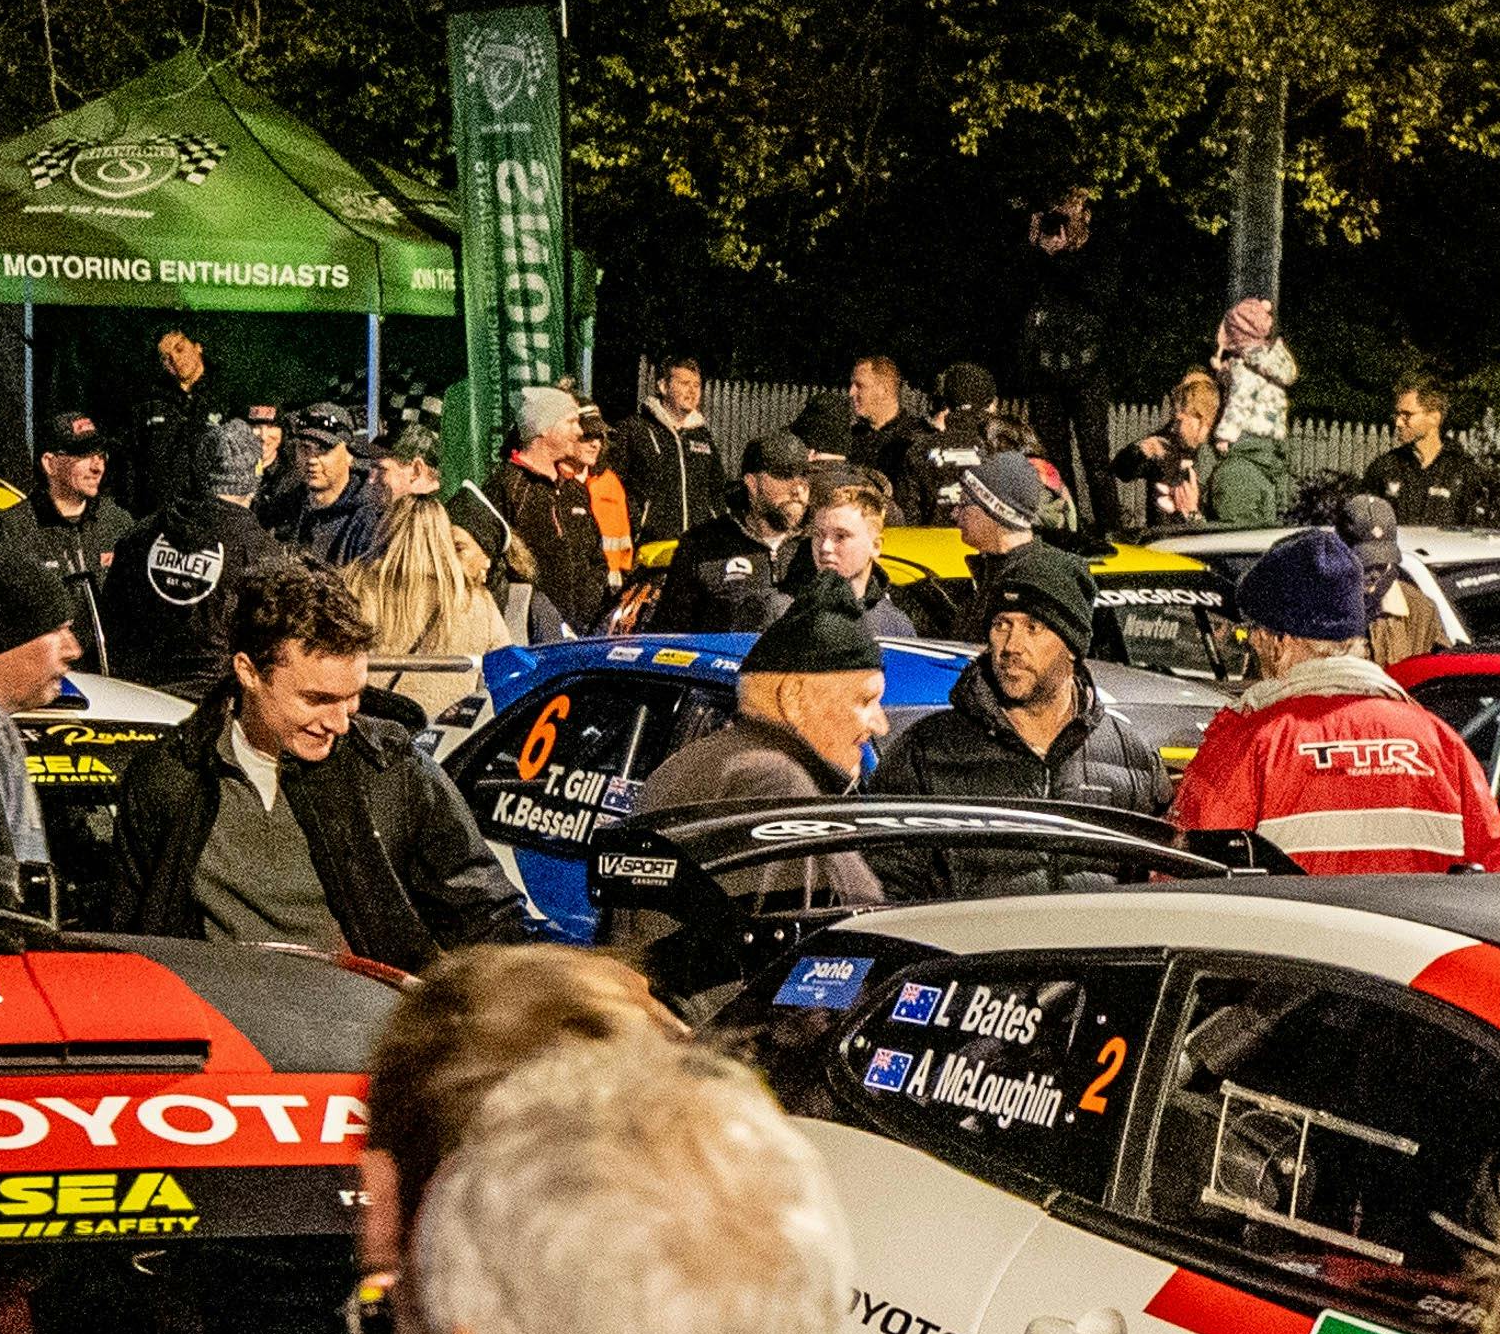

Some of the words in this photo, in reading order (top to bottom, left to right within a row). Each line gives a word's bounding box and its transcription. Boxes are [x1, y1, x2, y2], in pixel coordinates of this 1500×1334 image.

[3, 253, 151, 282] MOTORING
[159, 260, 350, 288] ENTHUSIASTS
[155, 549, 212, 576] OAKLEY
[516, 693, 571, 781] 6
[1299, 739, 1436, 777] TTR
[544, 764, 565, 798] T.
[564, 769, 607, 806] Gill
[933, 981, 958, 1027] L
[964, 986, 1043, 1045] Bates
[905, 1048, 934, 1096] A
[933, 1052, 1064, 1129] McLoughlin
[1078, 1036, 1128, 1114] 2
[74, 1216, 201, 1237] SAFETY
